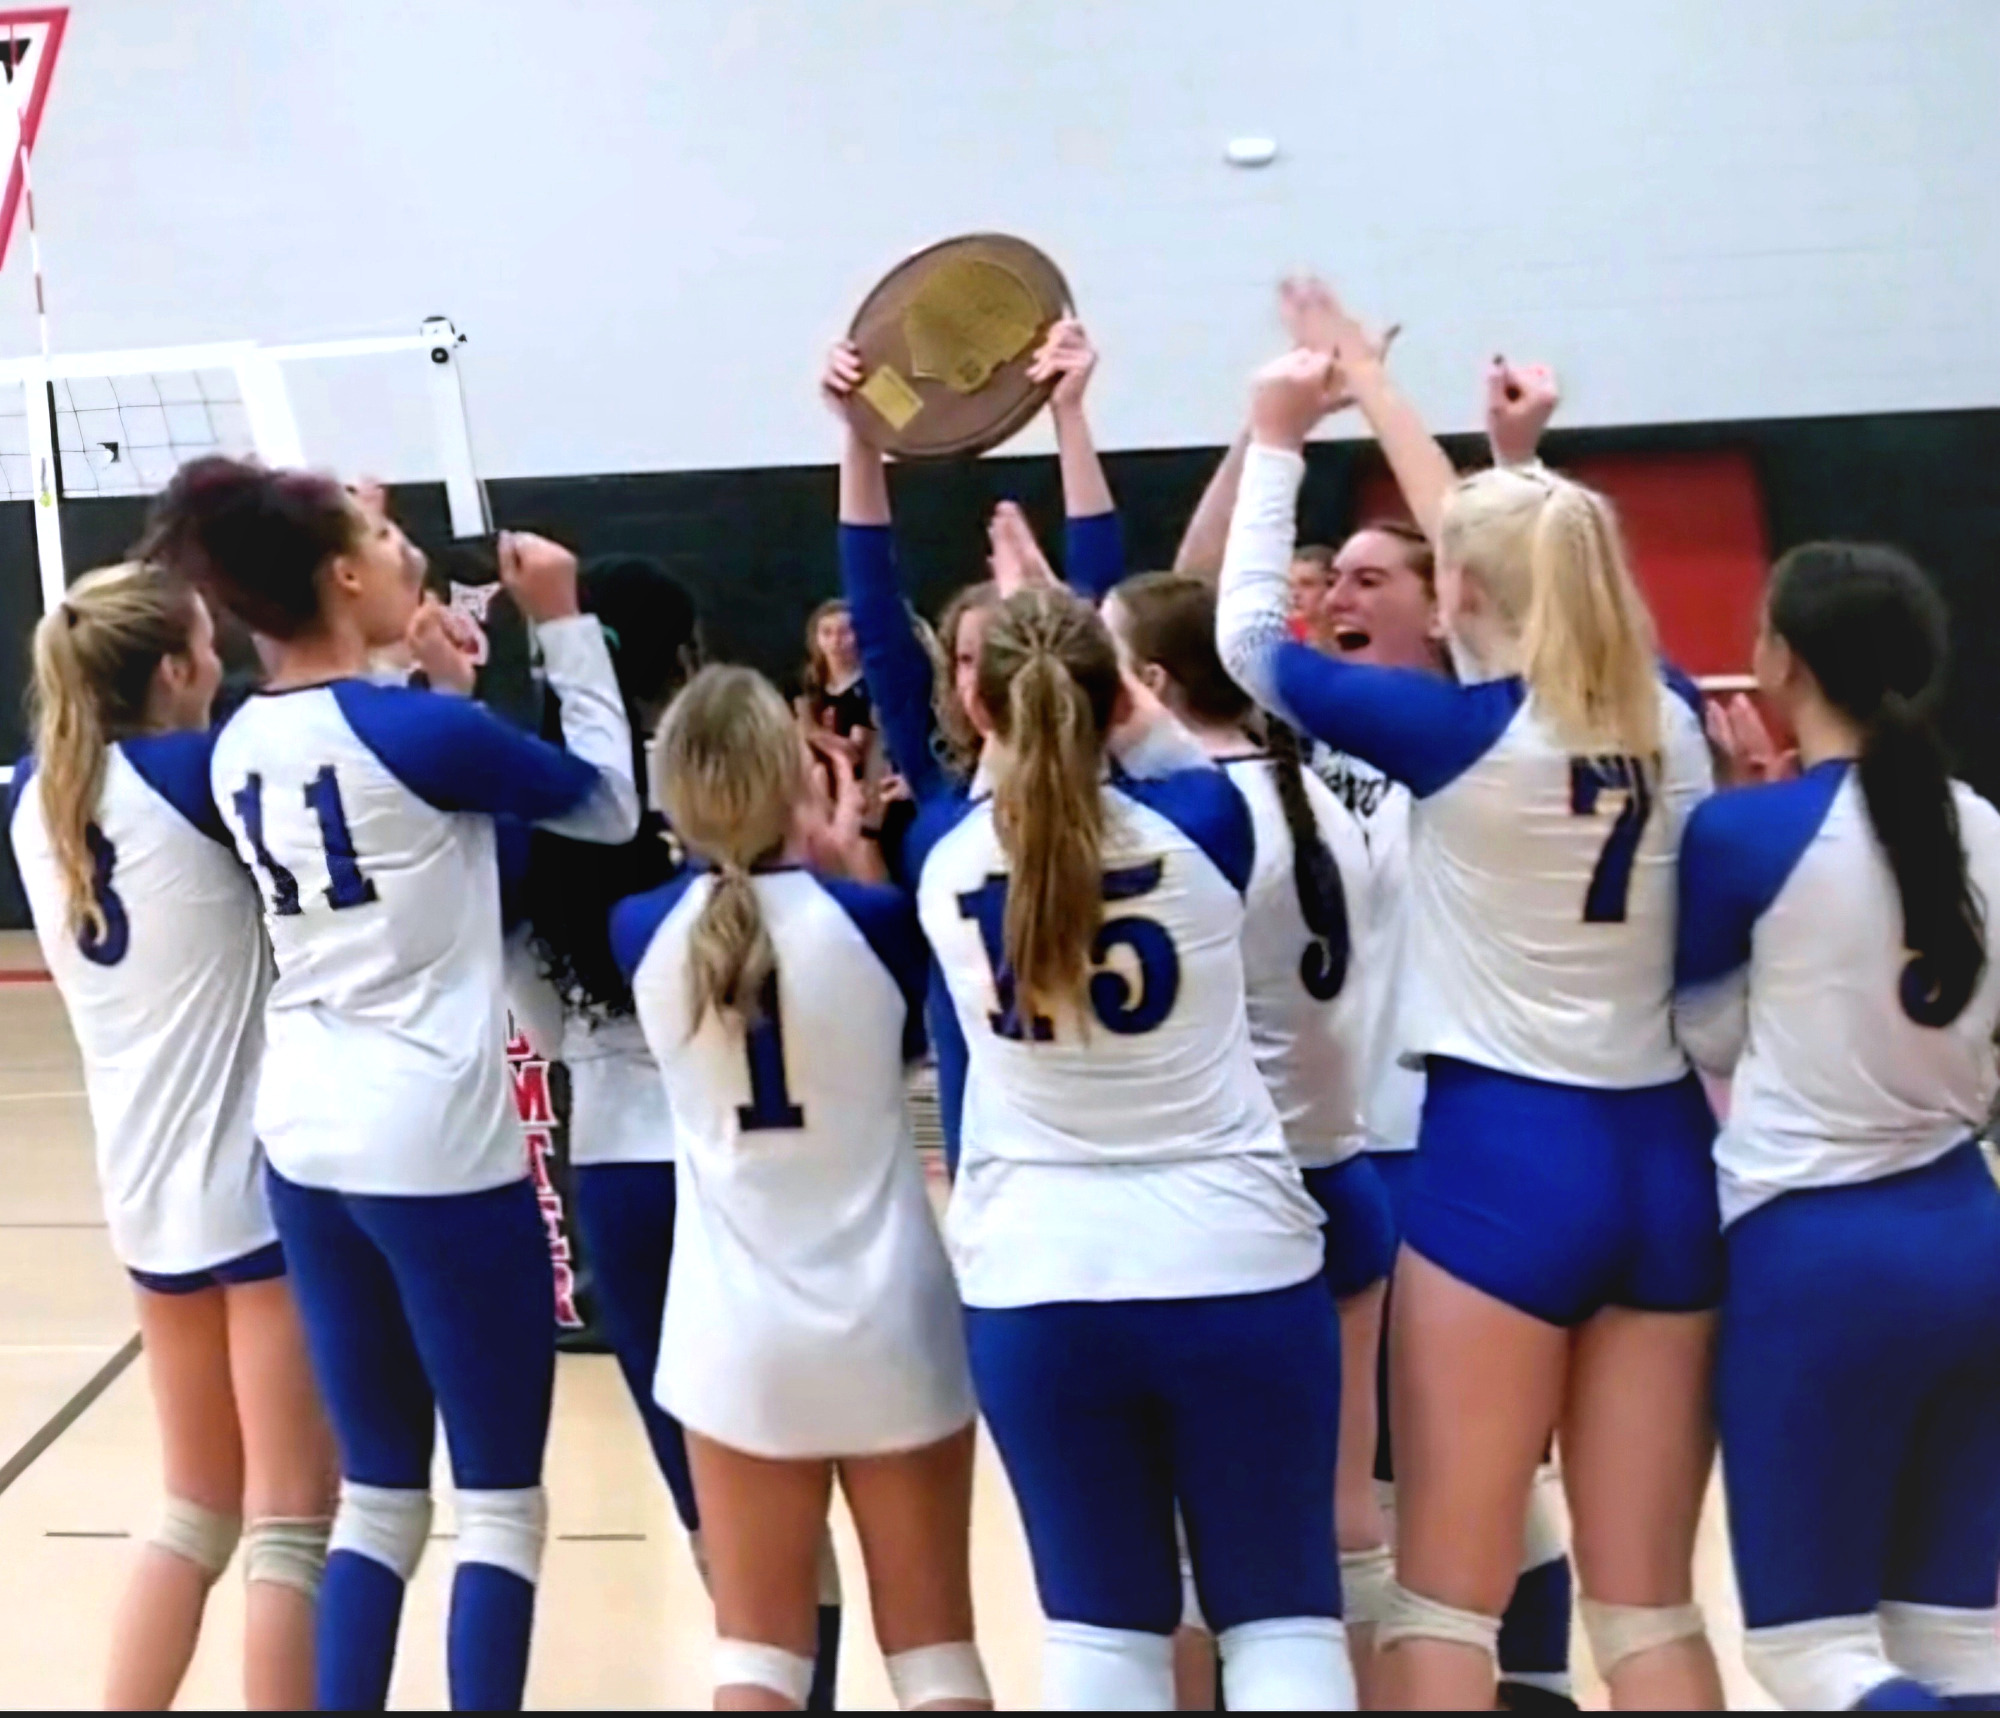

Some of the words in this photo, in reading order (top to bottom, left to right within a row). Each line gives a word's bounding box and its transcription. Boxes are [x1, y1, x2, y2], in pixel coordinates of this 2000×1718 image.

[232, 764, 380, 915] 11
[1569, 754, 1652, 922] 7
[955, 857, 1180, 1042] 15
[736, 964, 805, 1131] 1
